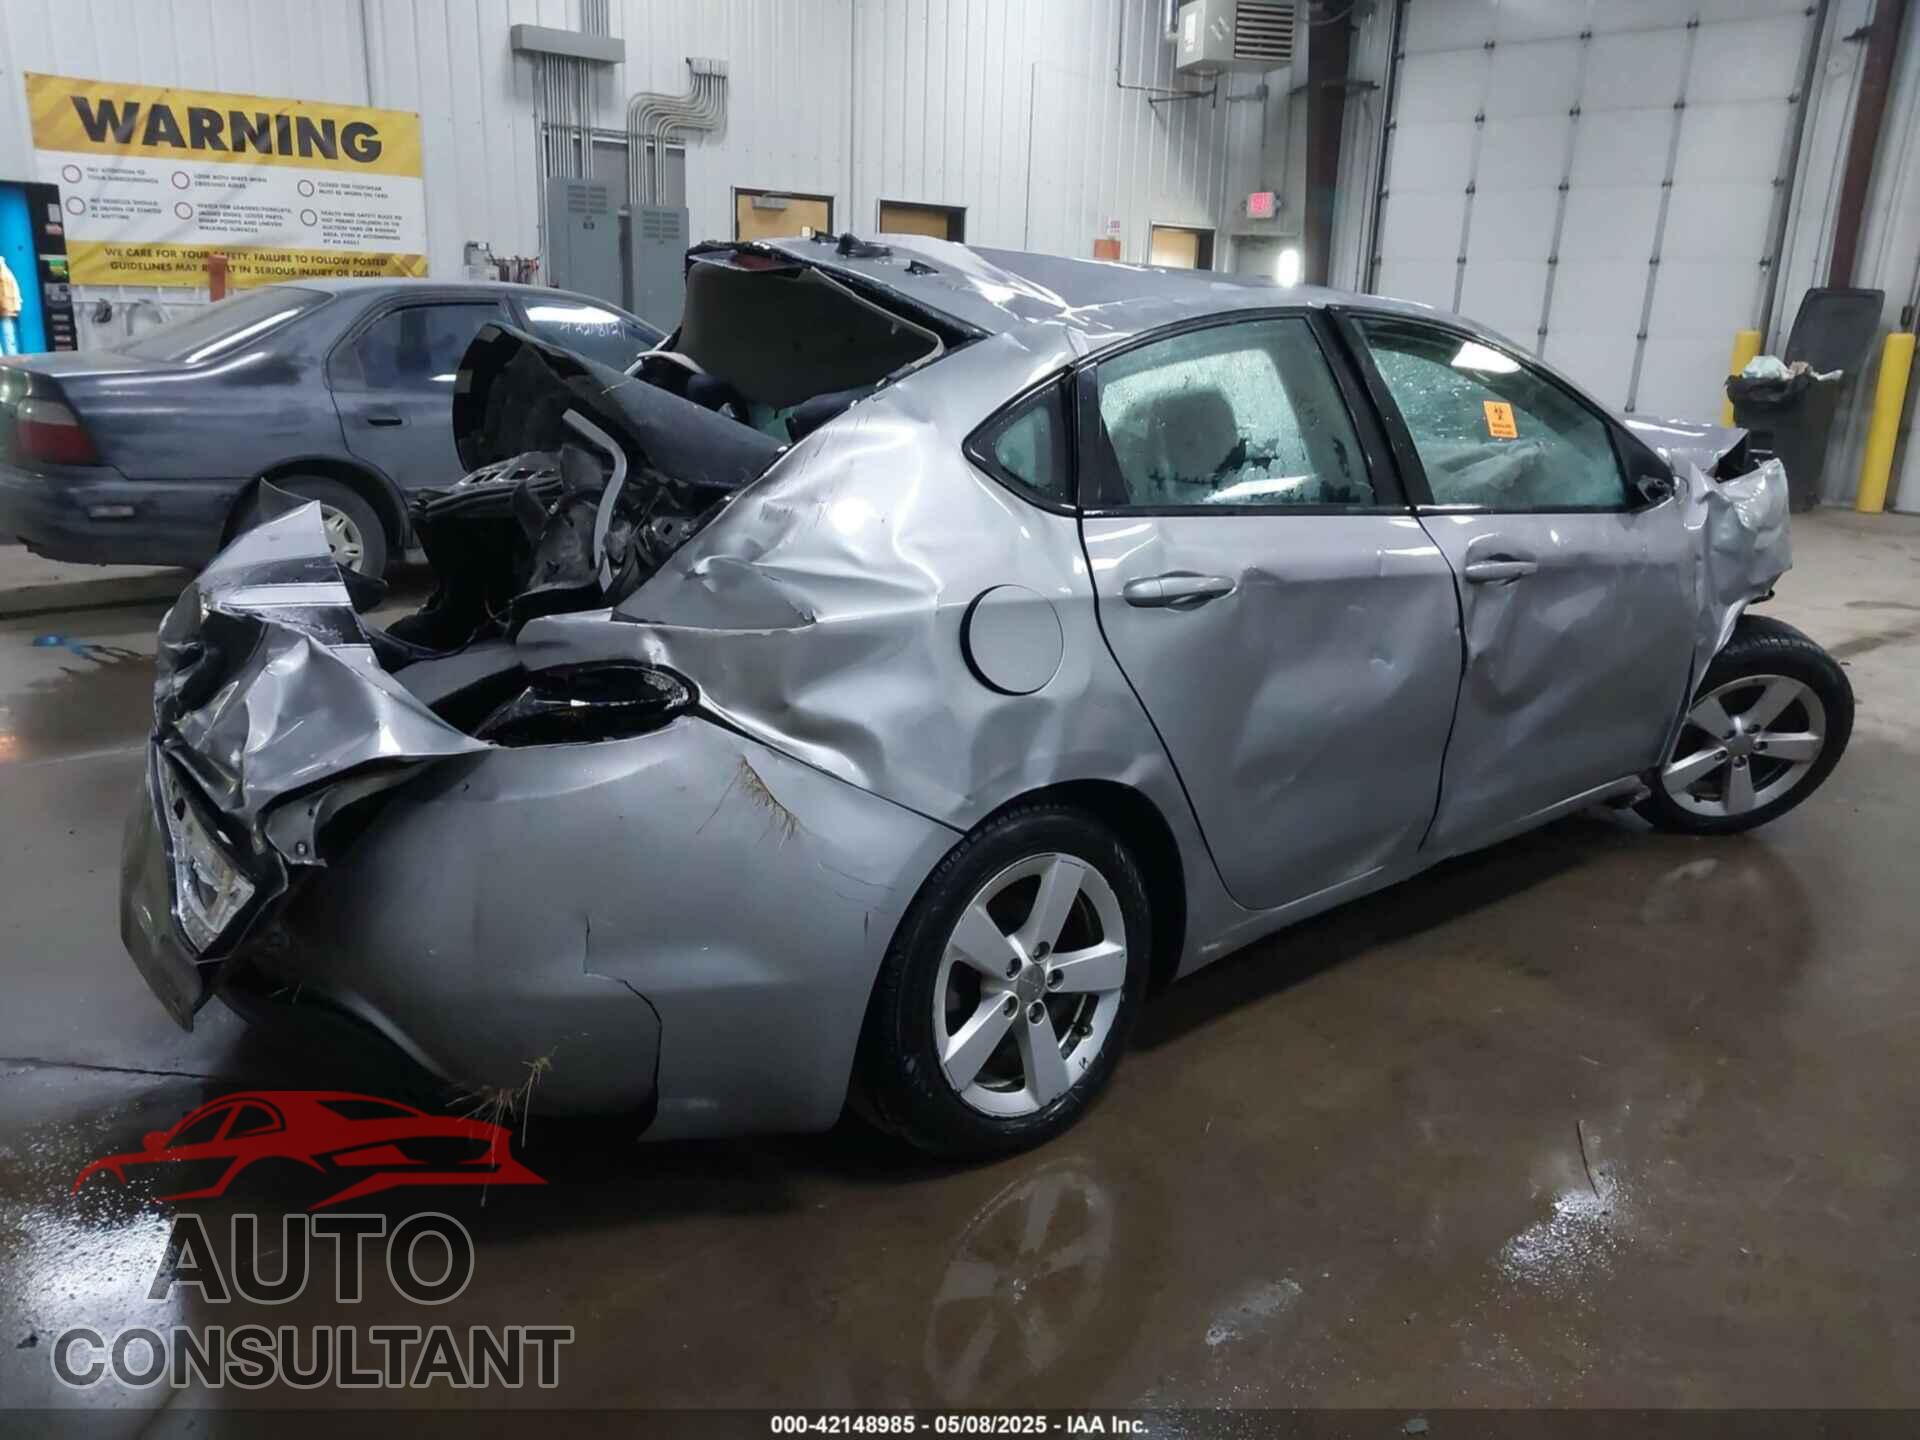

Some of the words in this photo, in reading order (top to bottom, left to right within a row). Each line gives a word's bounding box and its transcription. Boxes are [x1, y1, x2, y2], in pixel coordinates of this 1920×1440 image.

[70, 95, 383, 164] WARNING
[105, 248, 122, 257] WE
[126, 248, 152, 258] CARE
[156, 248, 177, 258] FOR
[181, 249, 209, 260] YOUR
[254, 252, 292, 263] FAILURE
[295, 253, 308, 264] TO
[311, 254, 350, 266] FOLLOW
[353, 256, 388, 267] POSTED
[110, 261, 172, 272] GUIDELINES
[175, 262, 198, 273] MAY
[240, 264, 251, 274] IN
[254, 265, 295, 276] SERIOUS
[298, 267, 332, 278] INJURY
[335, 268, 349, 278] OR
